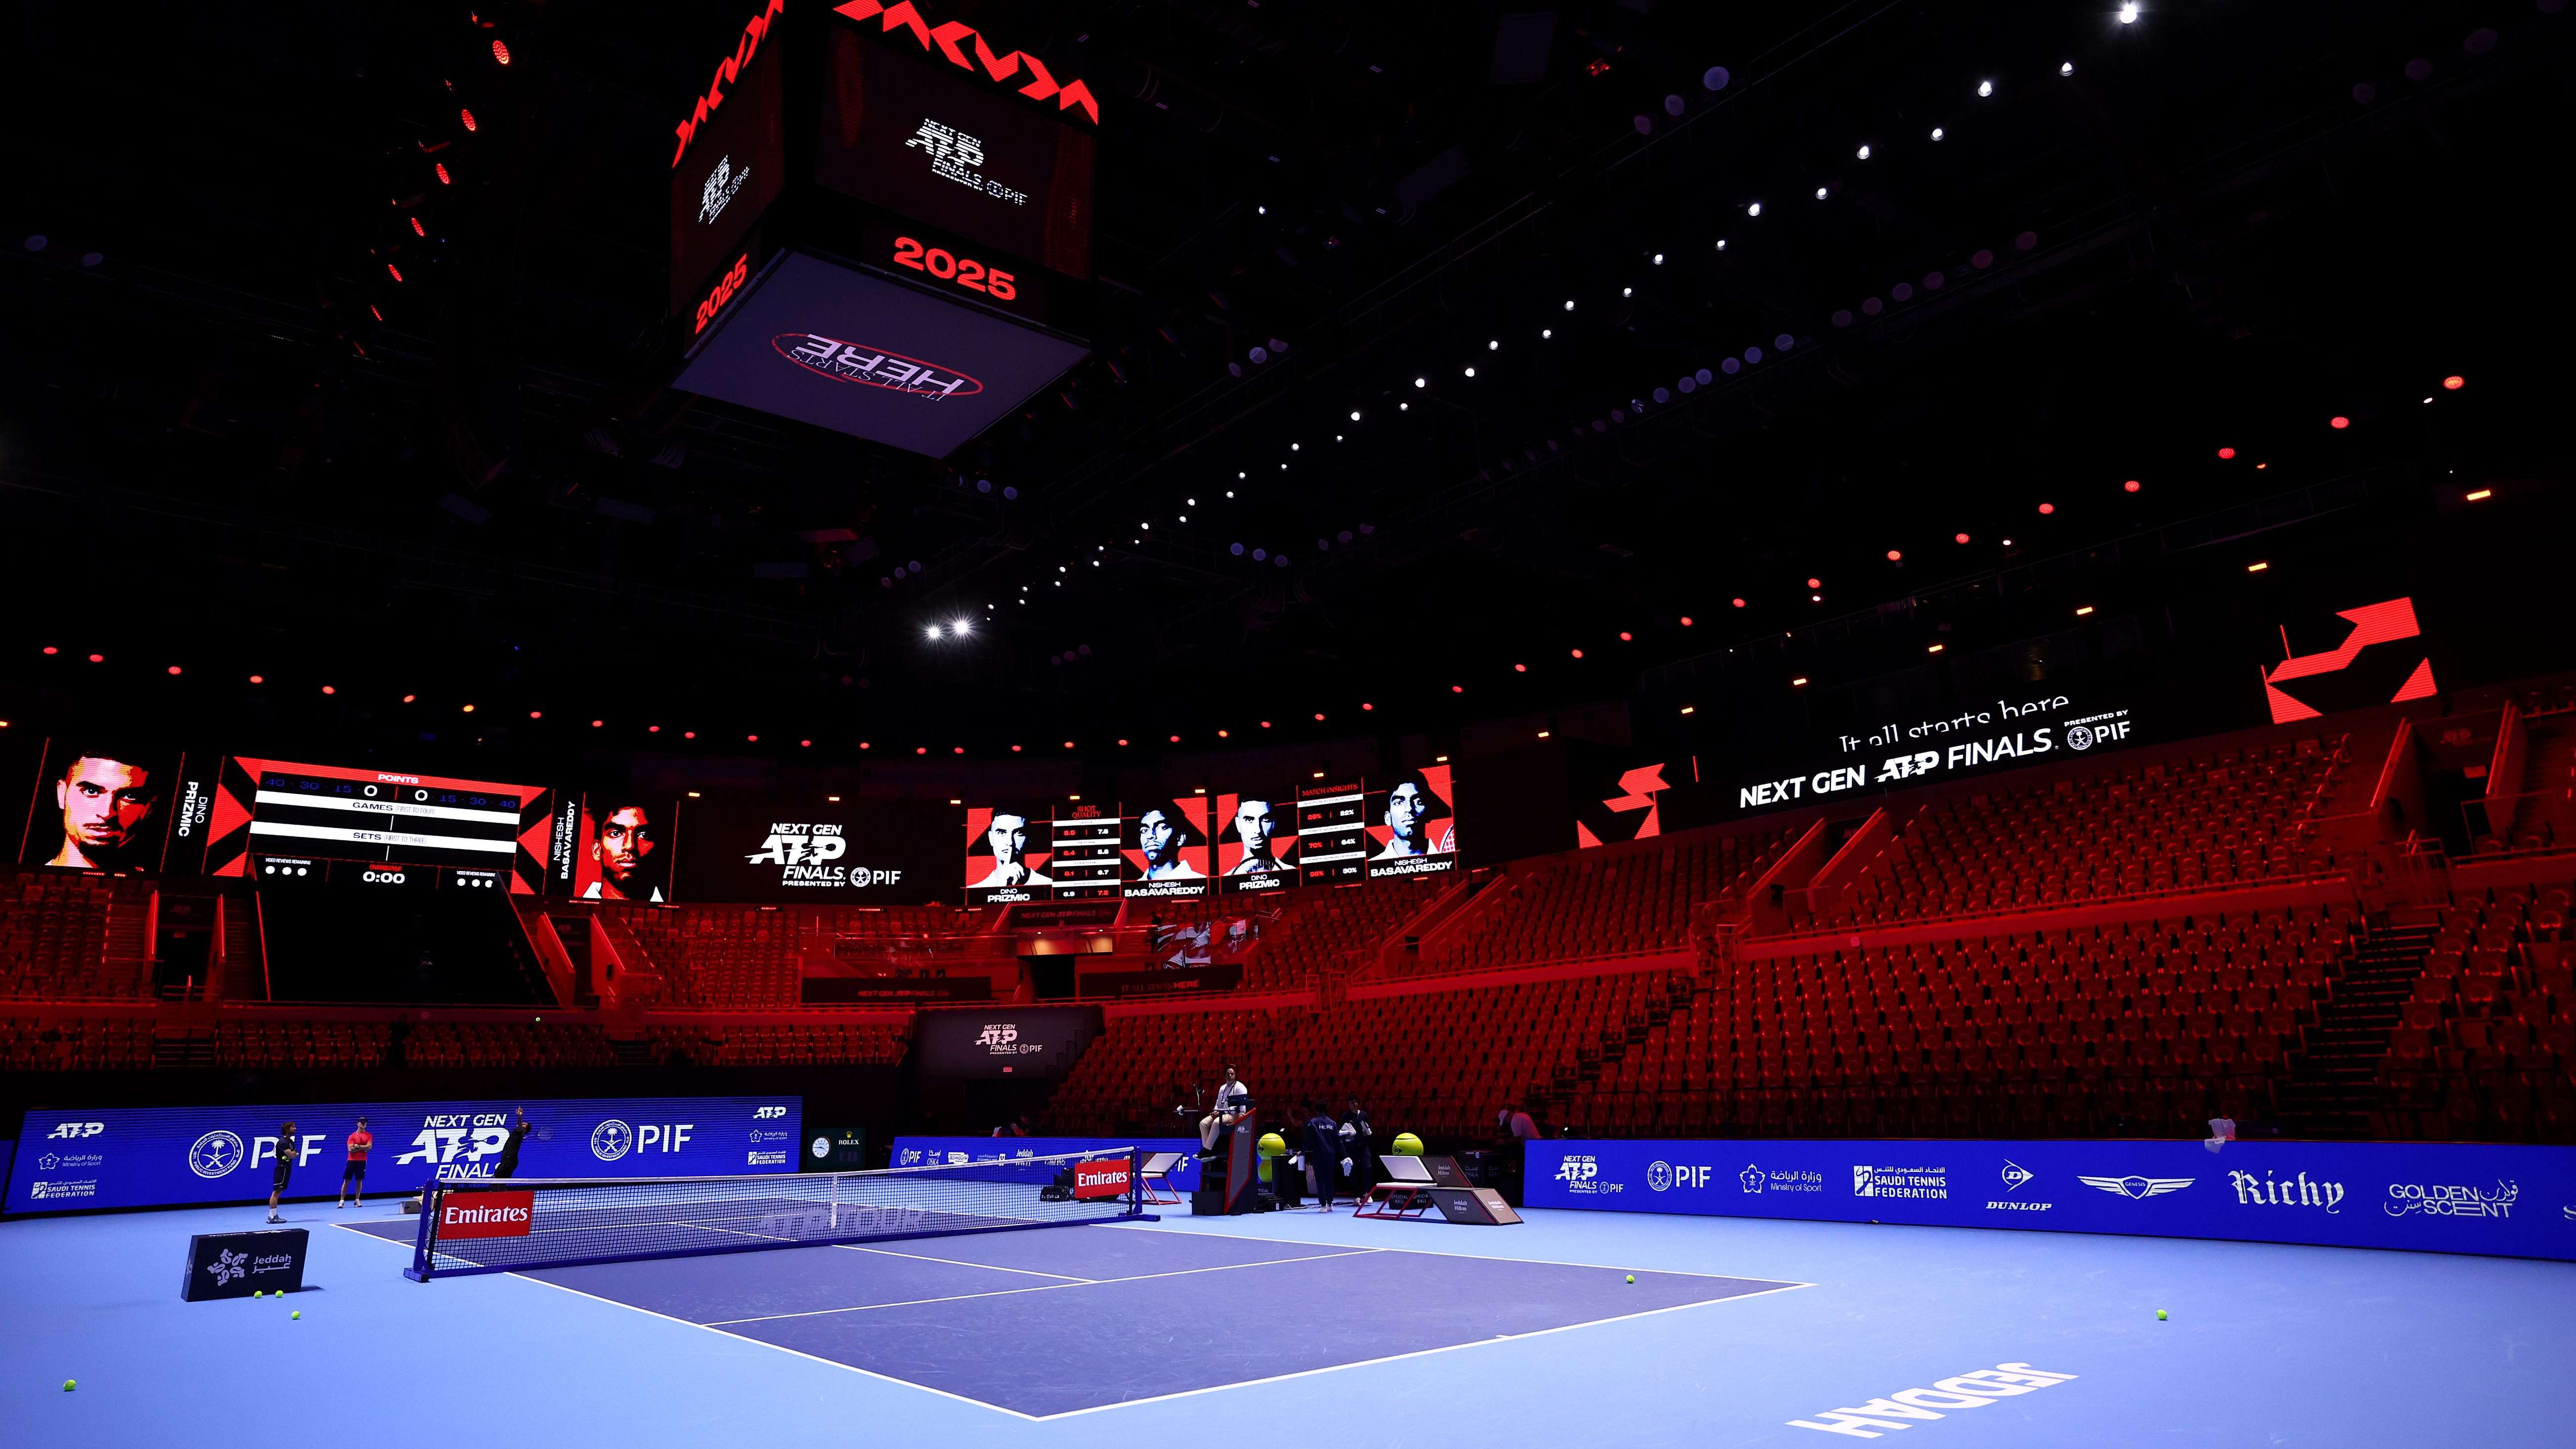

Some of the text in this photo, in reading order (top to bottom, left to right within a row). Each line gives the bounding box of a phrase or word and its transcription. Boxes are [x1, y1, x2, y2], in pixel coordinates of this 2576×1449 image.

[905, 126, 984, 167] ATP
[894, 236, 1016, 301] 2025
[695, 253, 748, 334] 2025
[796, 334, 965, 394] HERE
[787, 349, 946, 401] IT ALL STARTS
[1998, 696, 2069, 719] here
[2064, 712, 2114, 727] PRESENTED
[2094, 720, 2130, 743] PIF
[300, 781, 319, 790] 30
[378, 773, 419, 785] POINTS
[1740, 777, 1806, 808] NEXT
[1812, 765, 1865, 794] GEN
[1874, 750, 1939, 782] ATP
[1302, 783, 1358, 796] MATCH INSIGHTS
[353, 802, 393, 811] GAMES
[470, 797, 486, 805] 30
[178, 781, 199, 837] PRIZMIC
[194, 796, 208, 824] DINO
[1072, 810, 1101, 819] QUALITY
[353, 832, 381, 840] SETS
[770, 823, 842, 835] NEXT GEN
[554, 817, 565, 861] NISHESH
[560, 801, 576, 879] BASAVAREDDY
[744, 834, 846, 865] ATP
[1371, 861, 1452, 877] BASAVAREDDY
[1394, 858, 1427, 866] NISHESH
[363, 871, 405, 884] 0:00
[873, 870, 901, 884] PIF
[1240, 879, 1280, 890] PRIZMIC
[987, 893, 1030, 903] PRIZMIC
[1125, 886, 1205, 898] BASAVAREDDY
[1173, 980, 1199, 988] HERE
[974, 1030, 1018, 1045] ATP
[752, 1106, 786, 1118] ATP
[424, 1114, 507, 1128] NEXT GEN
[46, 1122, 104, 1139] ATP
[637, 1124, 694, 1153] PIF
[250, 1135, 326, 1169] PF
[391, 1127, 510, 1165] ATP
[1016, 1149, 1033, 1157] Jeddah
[909, 1151, 922, 1163] PIF
[1554, 1162, 1598, 1181] ATP
[1676, 1166, 1711, 1188] PIF
[1771, 1170, 1822, 1183] وزارة الرياضة
[1895, 1166, 1923, 1175] السعودي
[1077, 1171, 1127, 1186] Emirates
[1569, 1181, 1598, 1189] FINALS
[1874, 1176, 1946, 1186] SAUDI TENNIS
[1610, 1184, 1624, 1193] PIF
[1771, 1183, 1794, 1192] Ministry
[1804, 1184, 1822, 1192] Sport
[1875, 1187, 1947, 1199] FEDERATION
[2227, 1170, 2344, 1214] Richy
[2389, 1184, 2479, 1202] GOLDEN
[1986, 1201, 2052, 1211] DUNLOP
[2423, 1200, 2513, 1218] SCENT
[445, 1205, 528, 1224] Emirates
[253, 1254, 291, 1265] Jeddah
[1784, 1362, 2079, 1439] JEDDAH
